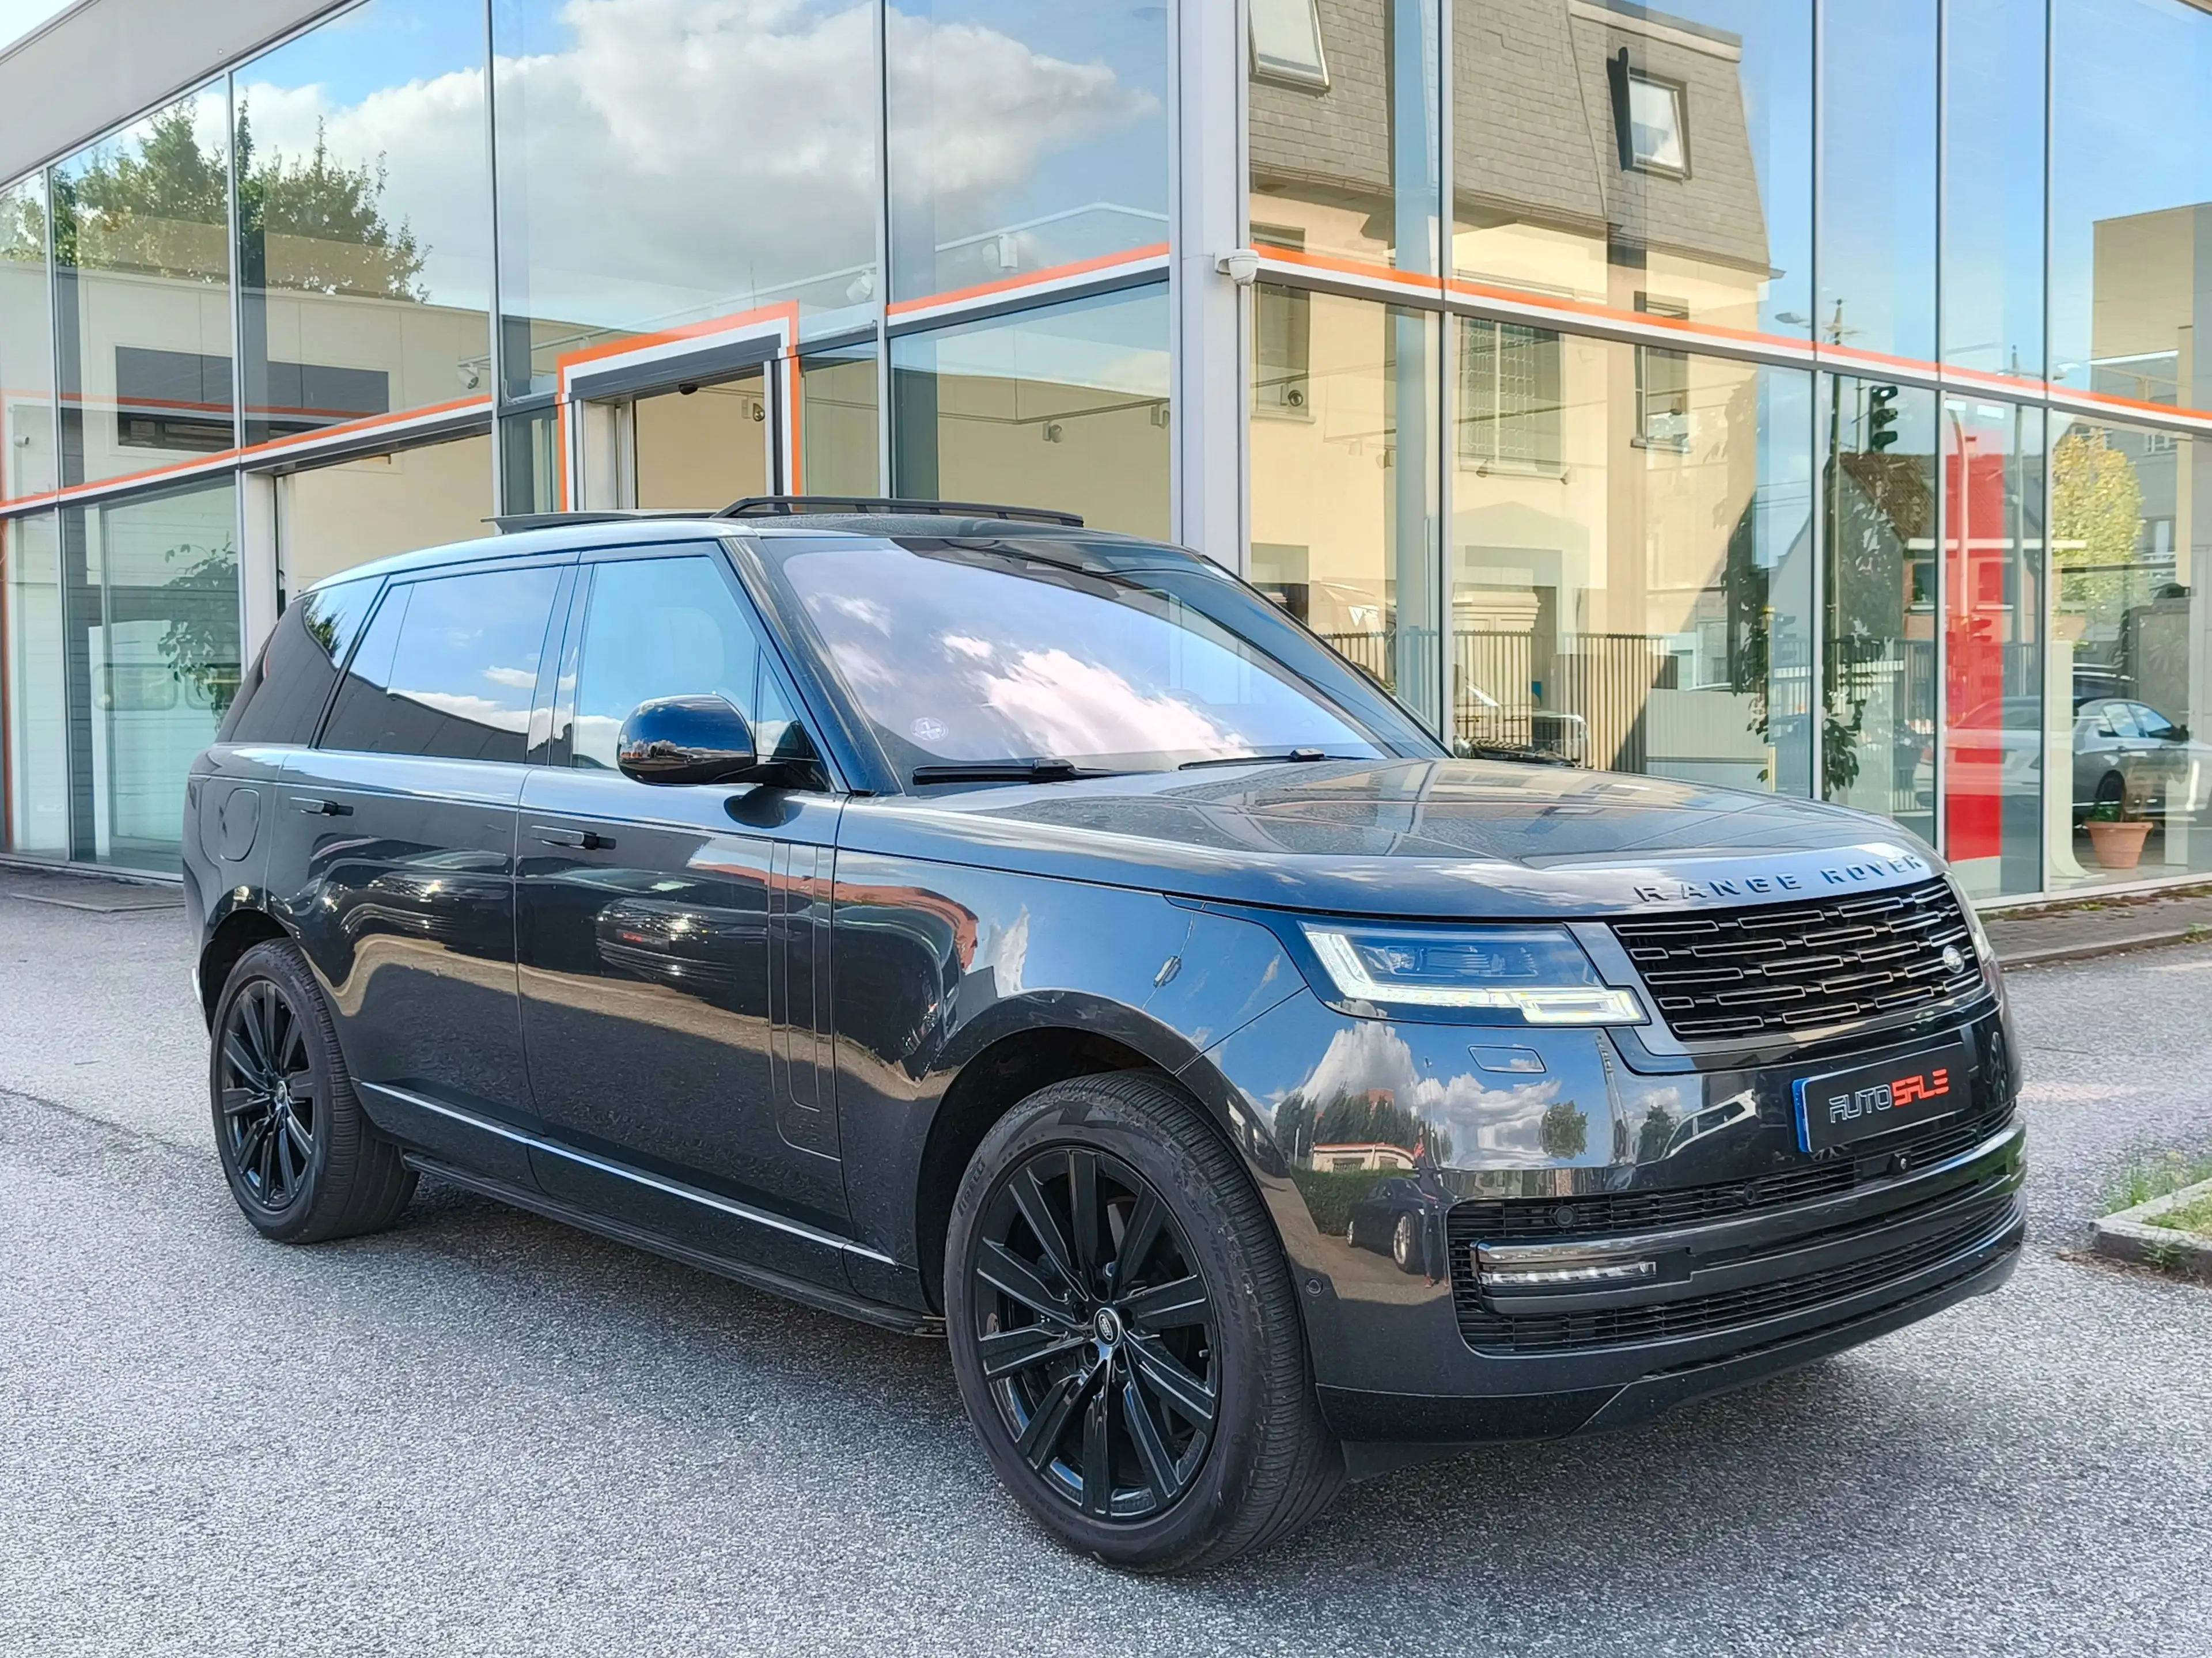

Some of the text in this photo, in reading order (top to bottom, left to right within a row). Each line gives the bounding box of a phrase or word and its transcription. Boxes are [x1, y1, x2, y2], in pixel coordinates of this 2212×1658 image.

[1633, 854, 1926, 902] RANGE ROVER
[957, 1154, 986, 1217] PIRELLI
